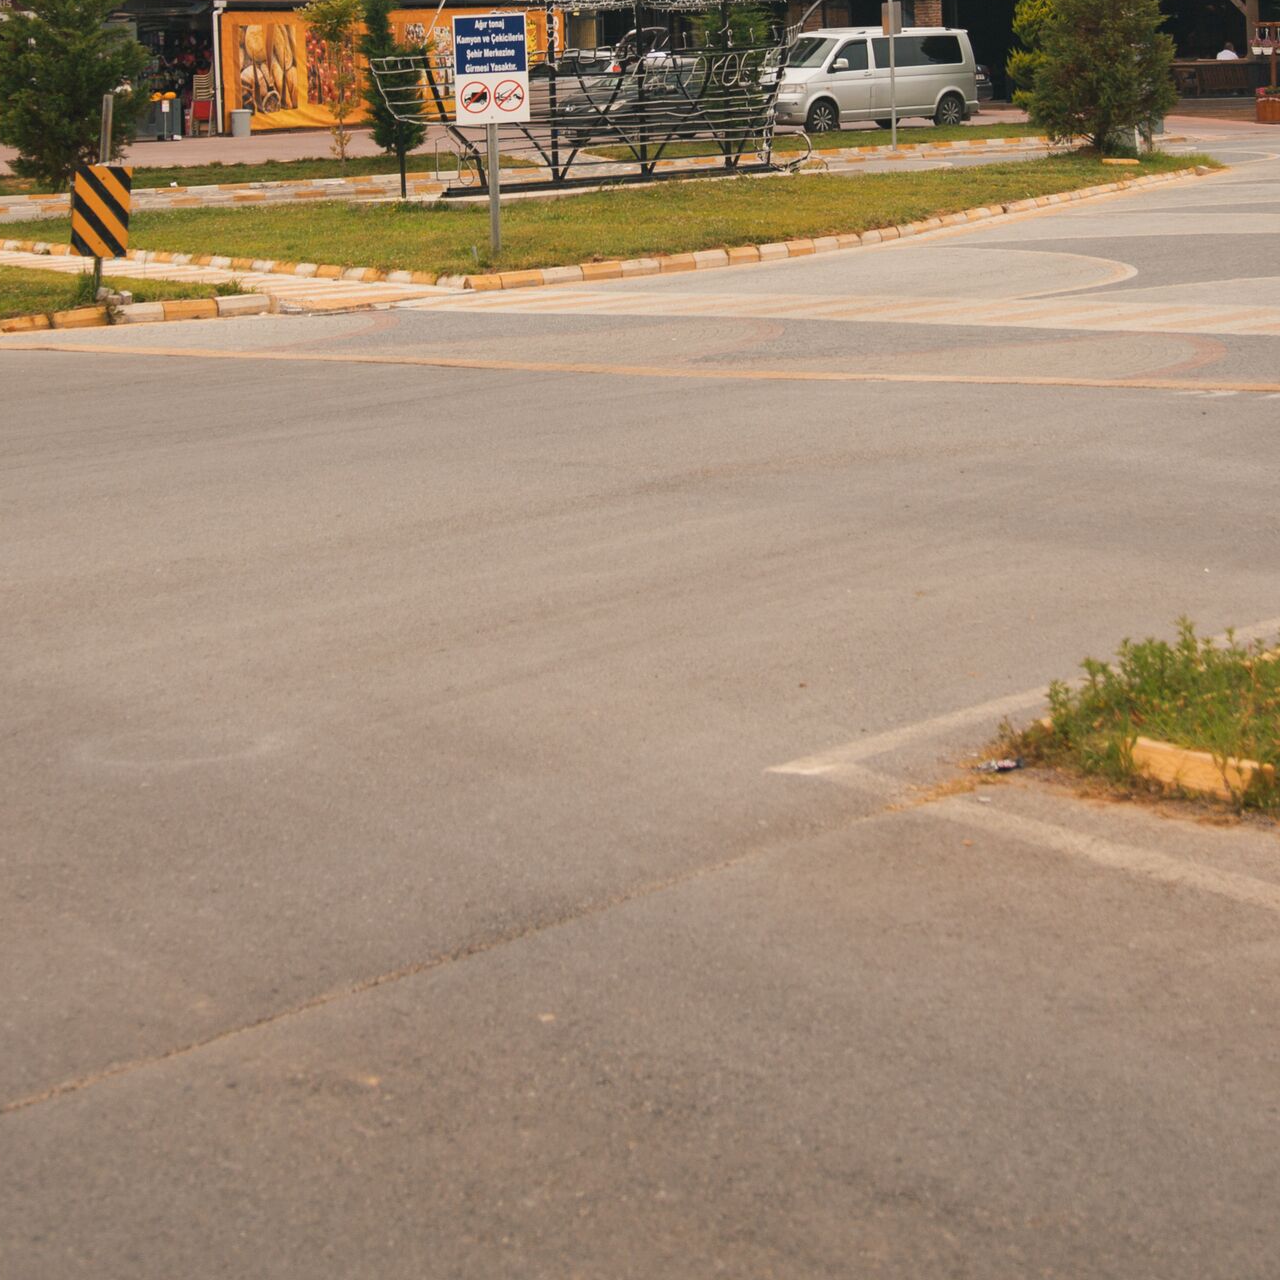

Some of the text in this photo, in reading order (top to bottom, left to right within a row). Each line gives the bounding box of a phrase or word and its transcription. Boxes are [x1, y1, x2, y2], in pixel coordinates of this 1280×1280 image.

[475, 19, 504, 30] Ağır tonaj
[456, 35, 481, 45] Kamyon
[491, 32, 524, 44] Çekicilerin
[466, 47, 515, 60] Şehir Merkezine
[465, 63, 489, 72] Girmesi
